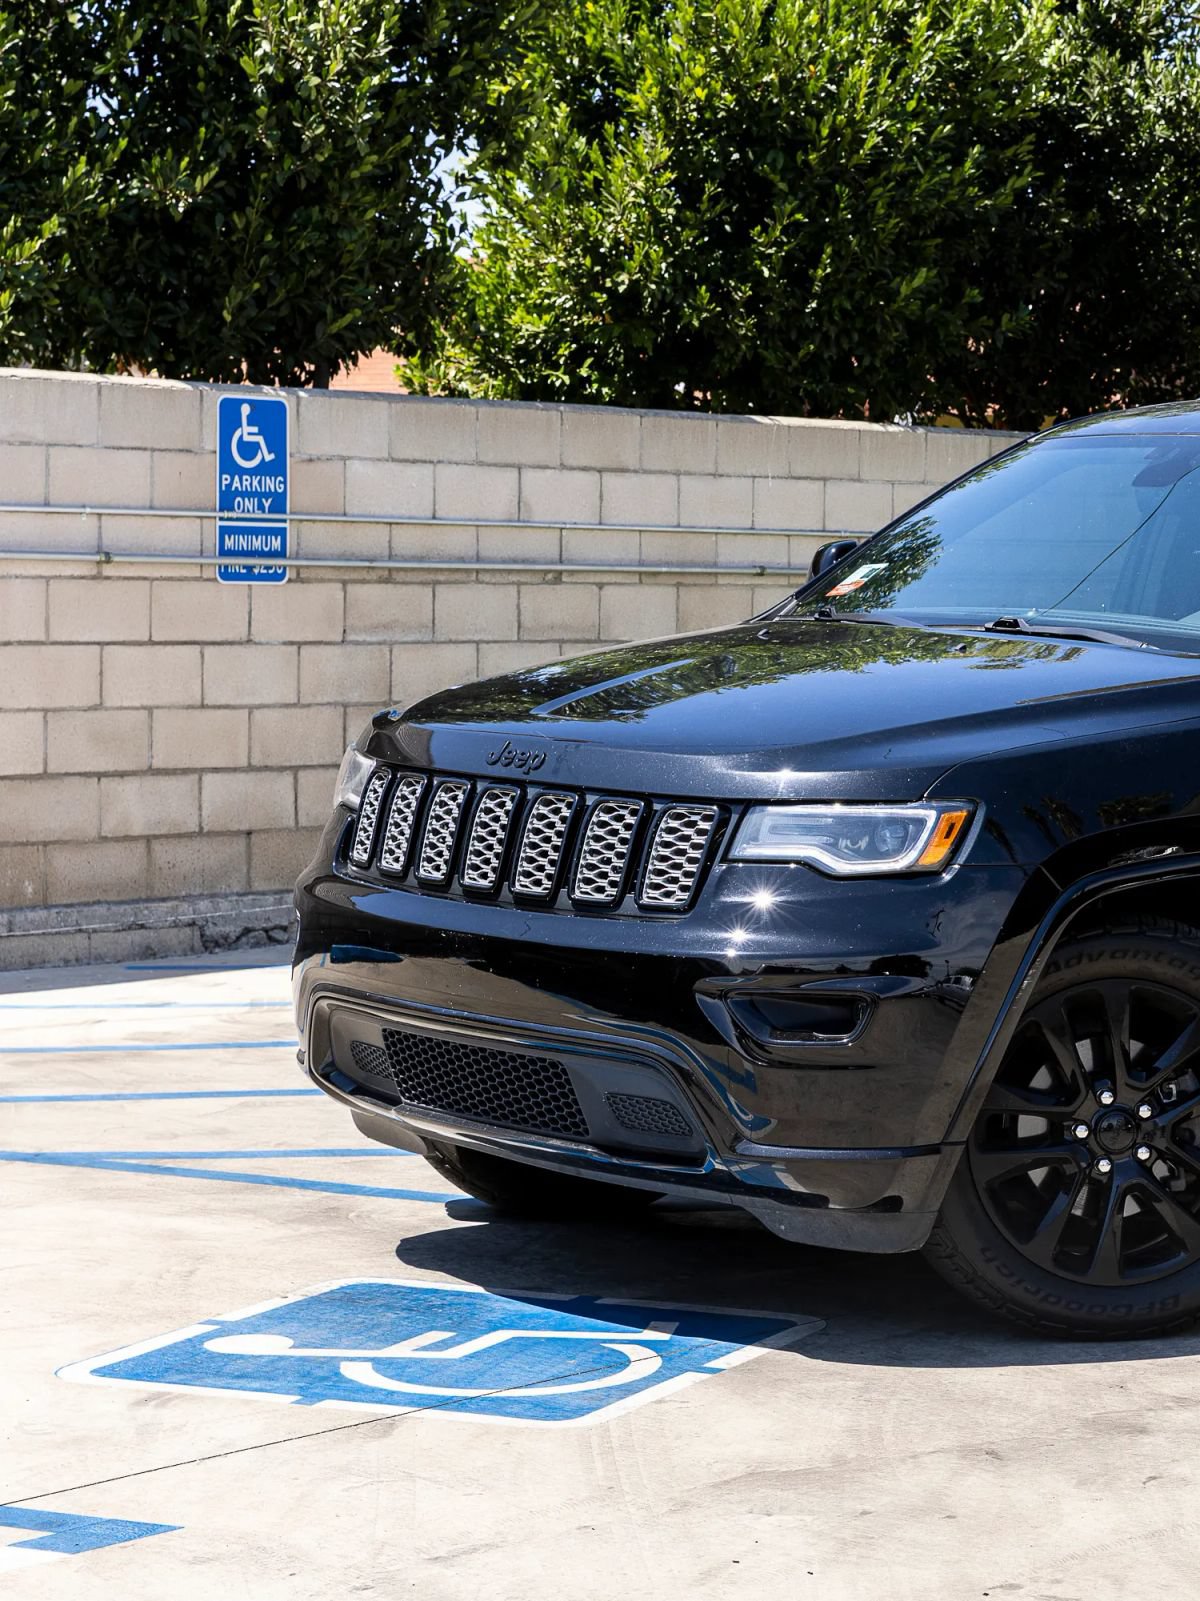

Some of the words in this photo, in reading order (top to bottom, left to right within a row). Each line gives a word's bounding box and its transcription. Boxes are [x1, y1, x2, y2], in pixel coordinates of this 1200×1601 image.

[221, 474, 285, 493] PARKING
[234, 497, 273, 514] ONLY
[224, 534, 282, 552] MINIMUM
[486, 740, 547, 775] Jeep
[980, 1246, 1181, 1318] BFGoodrich
